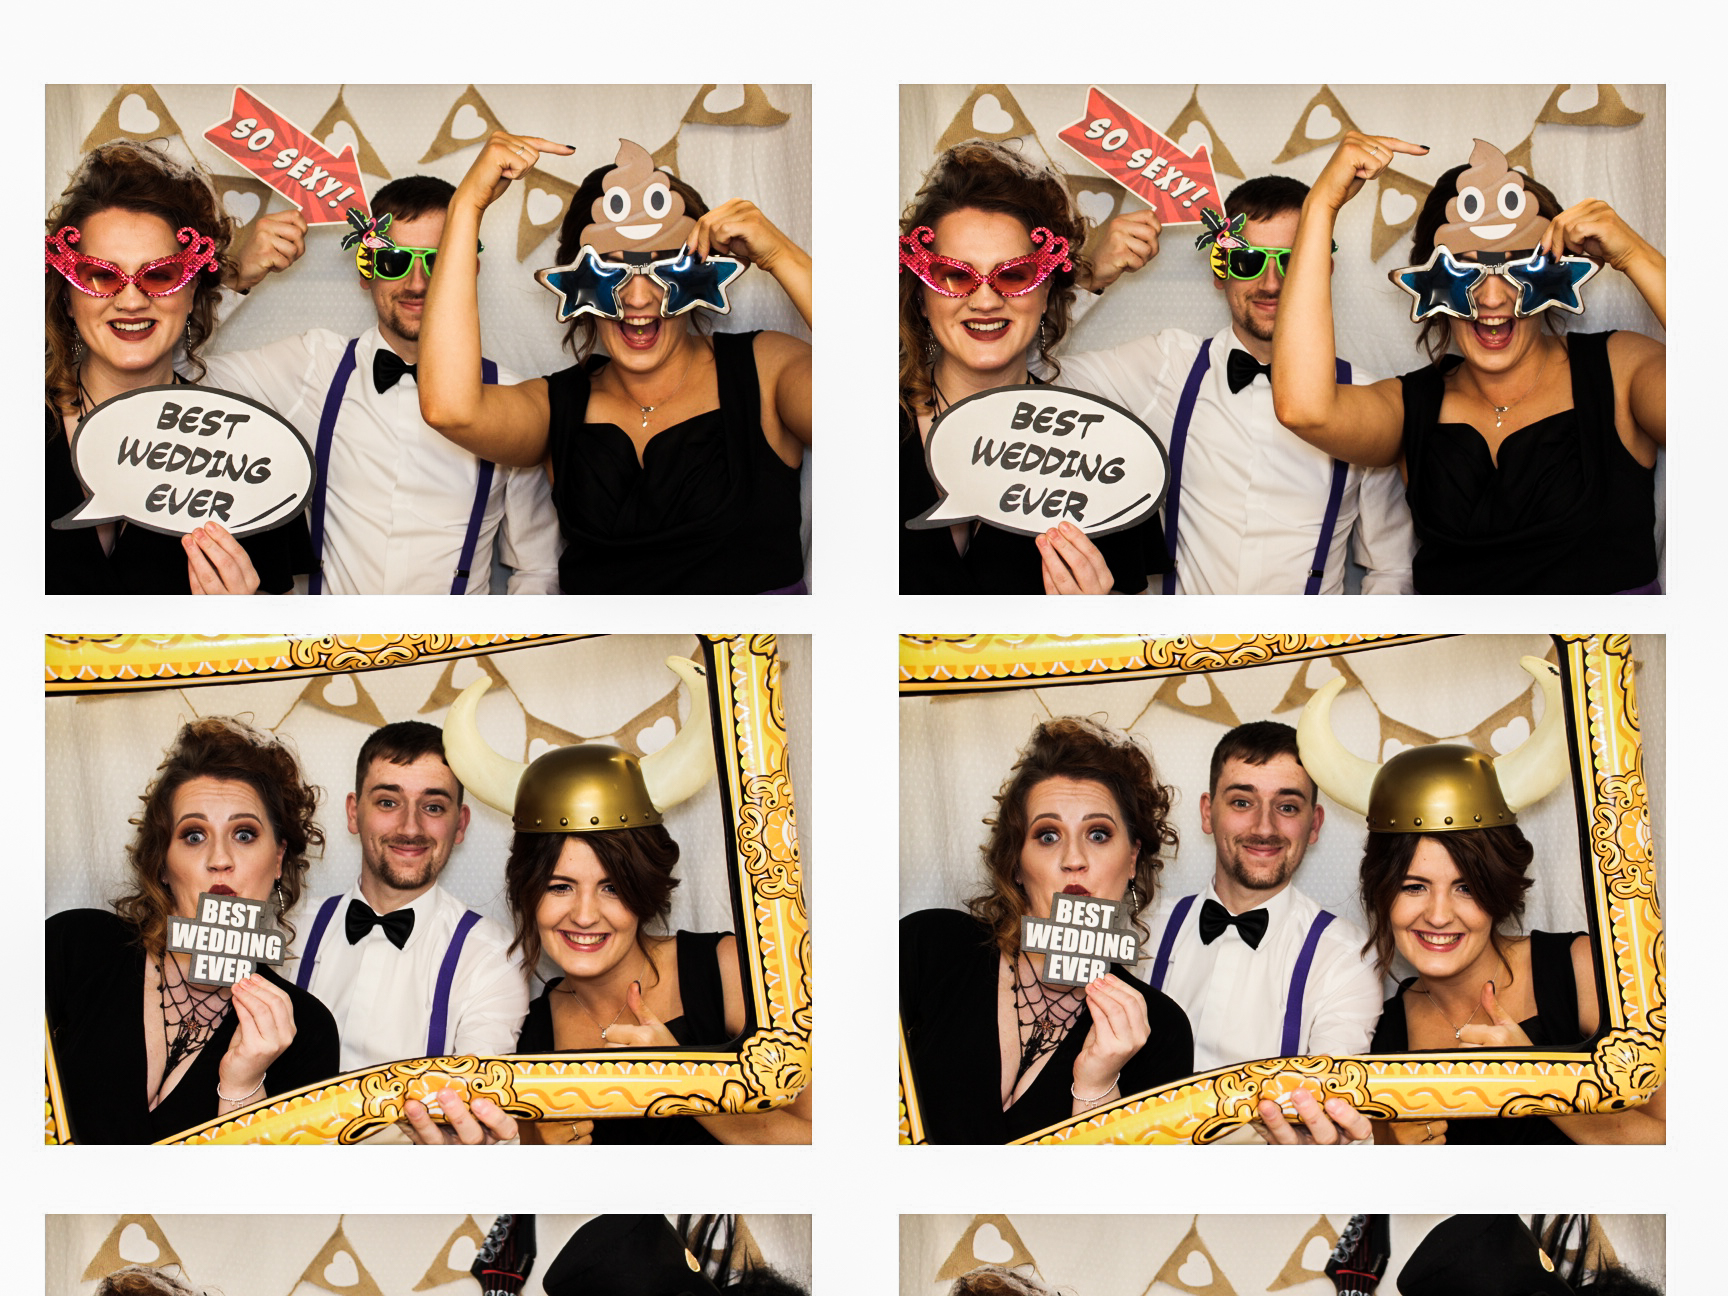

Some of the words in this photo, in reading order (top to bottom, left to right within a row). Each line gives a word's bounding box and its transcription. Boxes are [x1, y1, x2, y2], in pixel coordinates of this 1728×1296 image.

[230, 117, 275, 152] SO
[272, 147, 356, 208] SEXY!
[1084, 117, 1129, 152] SO
[1126, 147, 1210, 208] SEXY!
[156, 401, 251, 440] BEST
[1010, 401, 1105, 440] BEST
[117, 435, 272, 485] WEDDING
[971, 435, 1126, 485] WEDDING
[145, 483, 235, 522] EVER
[999, 483, 1089, 522] EVER
[201, 898, 261, 930] BEST
[1055, 898, 1115, 930] BEST
[171, 921, 282, 961] WEDDING
[1025, 921, 1136, 961] WEDDING
[194, 953, 252, 984] EVER
[1048, 953, 1106, 984] EVER
